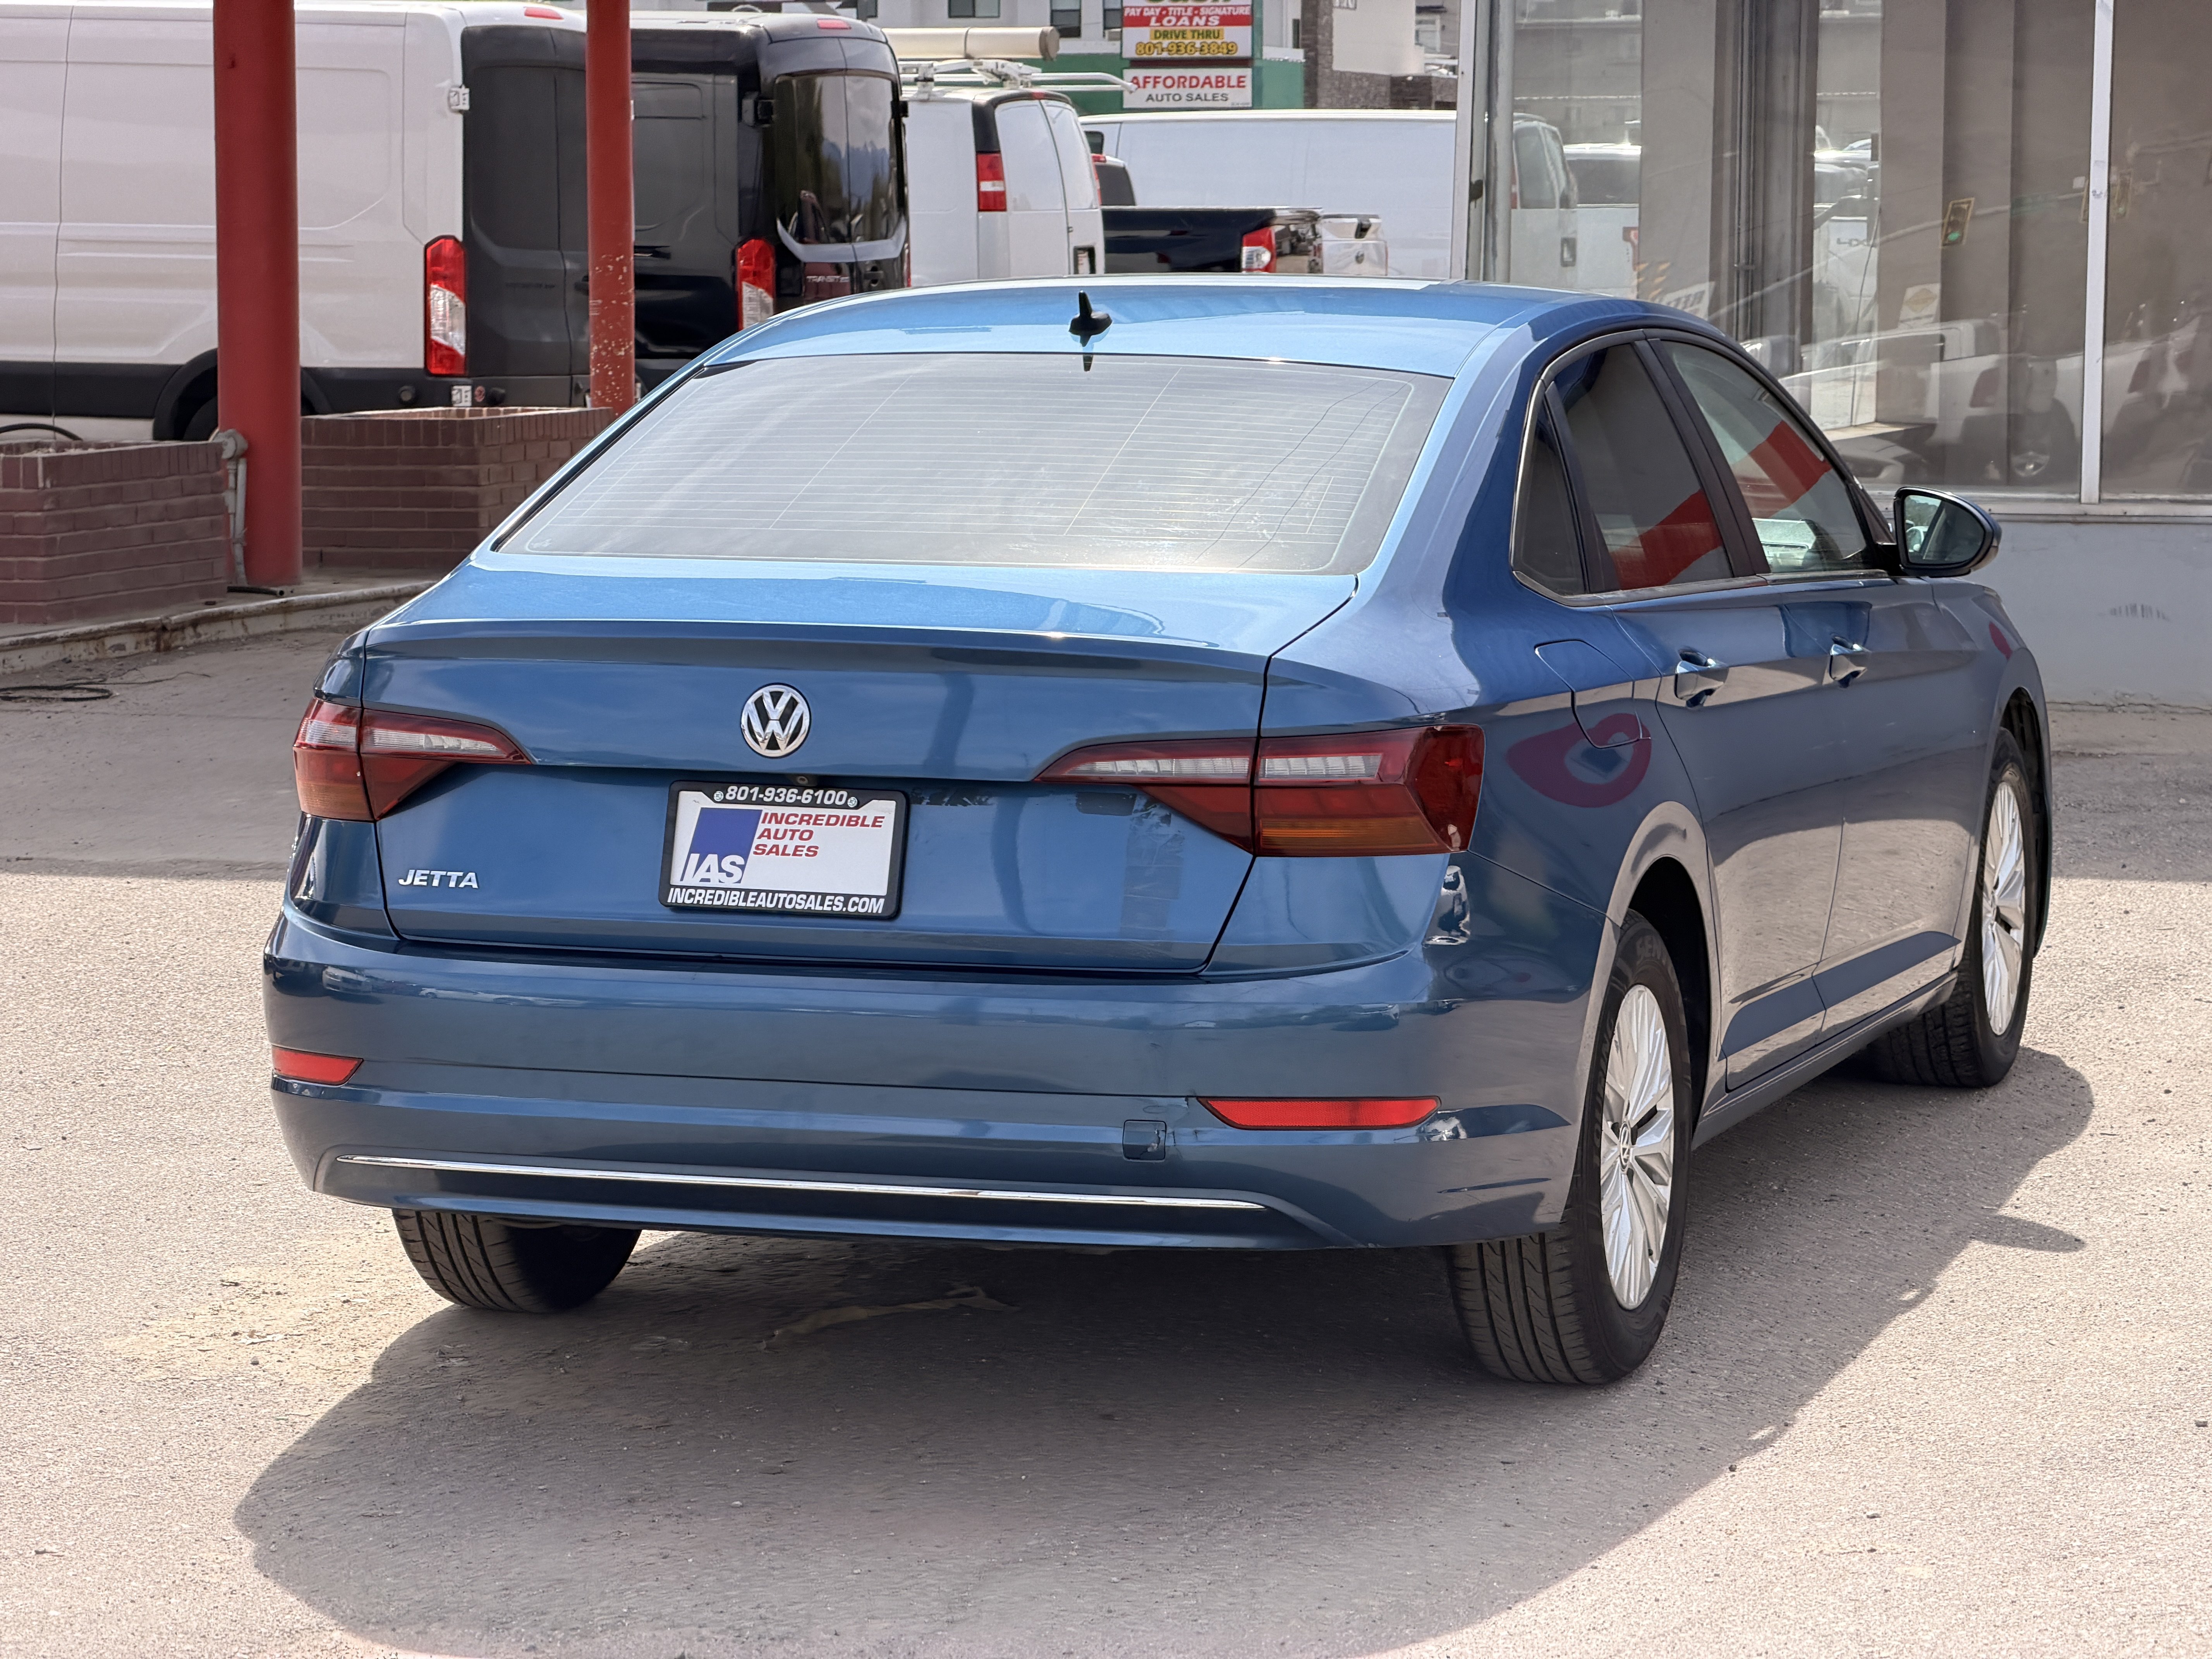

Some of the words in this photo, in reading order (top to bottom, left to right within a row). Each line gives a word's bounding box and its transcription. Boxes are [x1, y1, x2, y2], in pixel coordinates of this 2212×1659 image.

[1124, 7, 1142, 16] PAY
[1143, 7, 1161, 16] DAY
[1168, 7, 1193, 16] TITLE
[1200, 6, 1251, 15] SIGNATURE
[1149, 16, 1219, 26] LOANS
[1154, 29, 1187, 39] DRIVE
[1191, 29, 1220, 39] THRU
[1135, 41, 1238, 55] 801-936-3849
[1131, 76, 1247, 89] AFFORDABLE
[1146, 93, 1182, 102] AUTO
[1185, 93, 1228, 101] SALES
[725, 785, 848, 805] 801-936-6100
[761, 812, 885, 828] INCREDIBLE
[757, 829, 814, 841] AUTO
[752, 844, 819, 857] SALES
[683, 853, 745, 884] IAS
[398, 869, 479, 889] JETTA
[667, 888, 884, 914] INCREDIBLEAUTOSALES.COM
